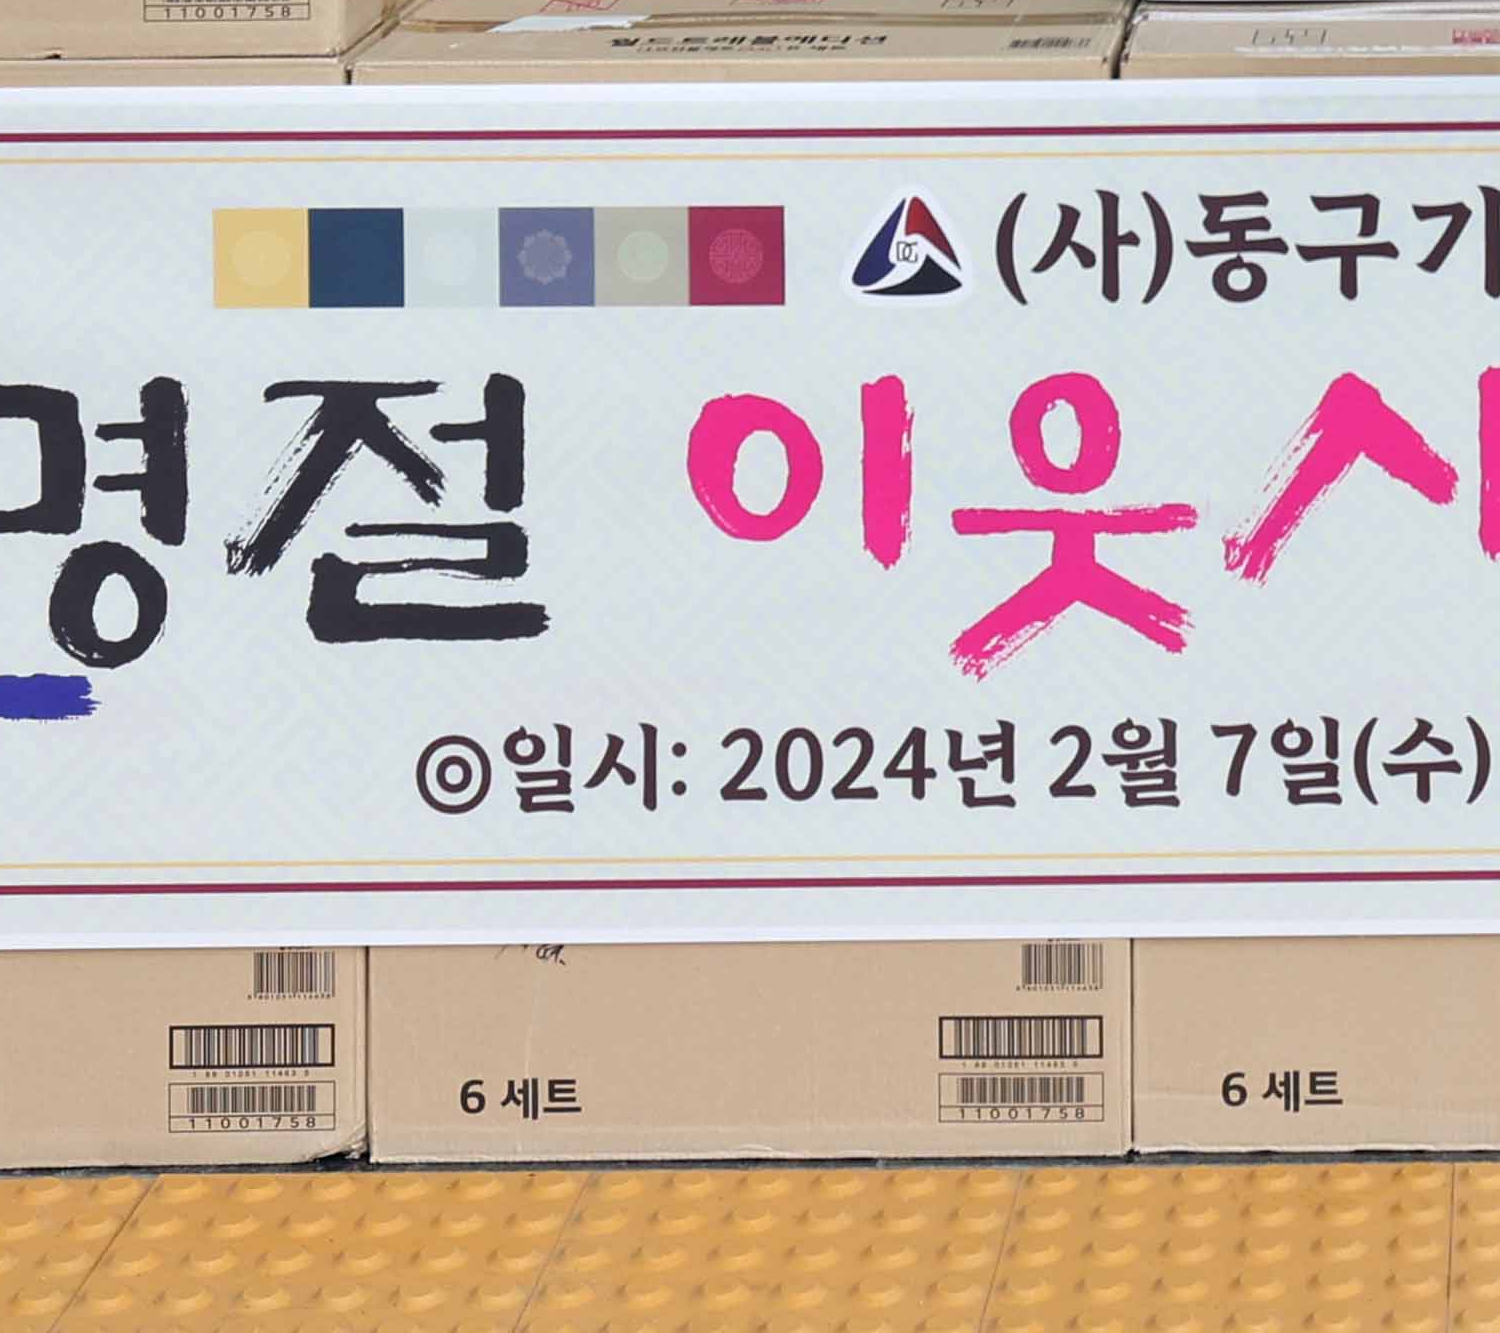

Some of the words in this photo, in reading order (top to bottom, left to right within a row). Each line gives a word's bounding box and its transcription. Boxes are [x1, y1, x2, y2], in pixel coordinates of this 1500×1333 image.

[163, 5, 294, 21] 11001758
[719, 719, 1019, 810] 2024년
[1048, 717, 1180, 808] 2월
[1210, 716, 1492, 811] 7일(수)
[1222, 1072, 1247, 1107] 6
[1262, 1070, 1343, 1113] 세트
